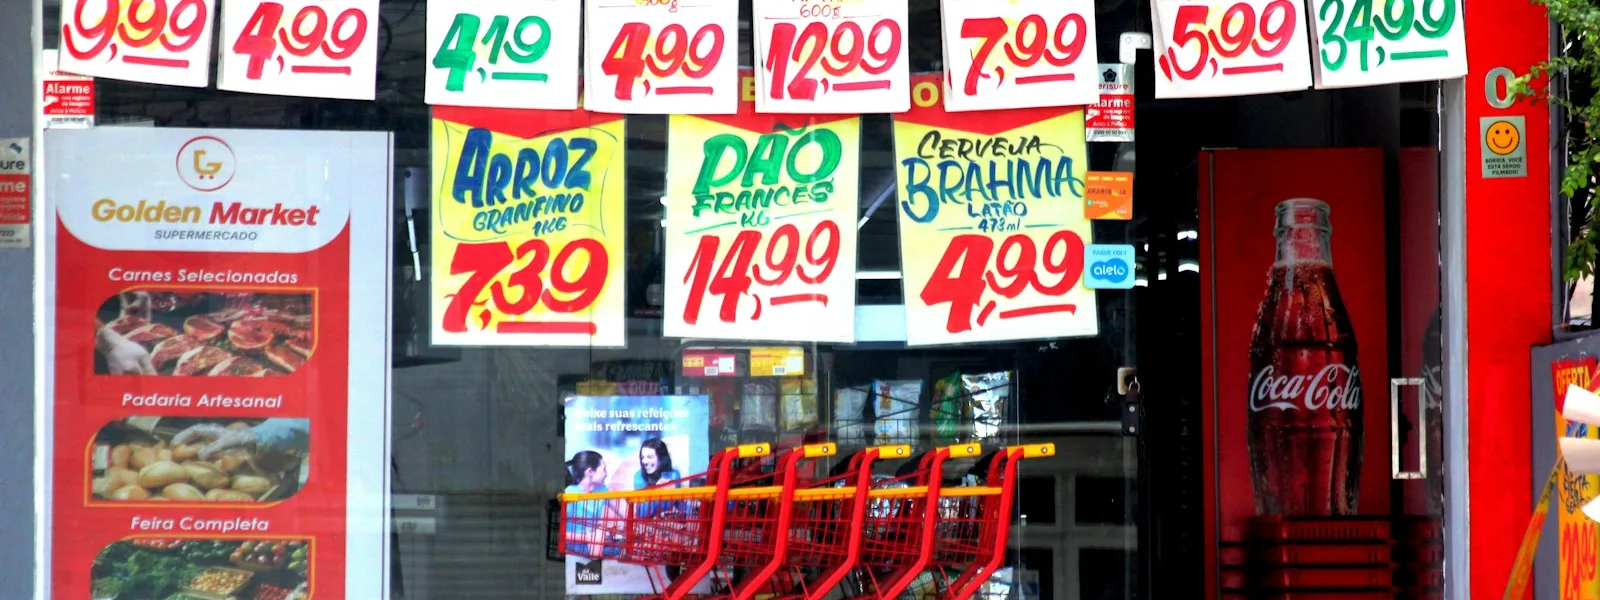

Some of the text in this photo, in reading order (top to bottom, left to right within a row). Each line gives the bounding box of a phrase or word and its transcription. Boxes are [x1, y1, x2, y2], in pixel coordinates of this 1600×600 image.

[799, 4, 841, 19] 600g
[63, 0, 207, 63] 9,99
[232, 1, 368, 80] 4,99
[1319, 0, 1456, 71] 34,99
[432, 13, 551, 92] 4,19
[601, 22, 725, 100] 4,99
[766, 19, 902, 102] 12,99
[961, 13, 1087, 96] 7,99
[46, 83, 91, 94] Alarme
[1088, 98, 1132, 108] arme
[691, 122, 843, 195] PÃO
[917, 130, 1064, 161] CERVEJA
[452, 127, 598, 208] ARROZ
[901, 155, 1086, 223] BRAHMA
[91, 198, 321, 227] Golden Market
[473, 192, 584, 235] GRANFINO
[740, 211, 771, 229] KG
[967, 201, 1028, 218] LATÃO
[154, 229, 258, 241] SUPERMERCADO
[532, 215, 567, 237] 1KG
[107, 267, 298, 284] Carnes Selecionadas
[442, 238, 609, 332] 7,39
[683, 219, 841, 326] 14,99
[920, 230, 1085, 334] 4,99
[1093, 263, 1126, 276] alelo
[1249, 363, 1361, 412] Coca-Cola
[1555, 365, 1591, 397] OFERTA
[121, 393, 282, 409] Padaria Artesanal
[574, 407, 607, 418] ixe
[609, 409, 635, 418] suas
[130, 516, 270, 534] Feira Completa
[577, 573, 600, 582] Valle
